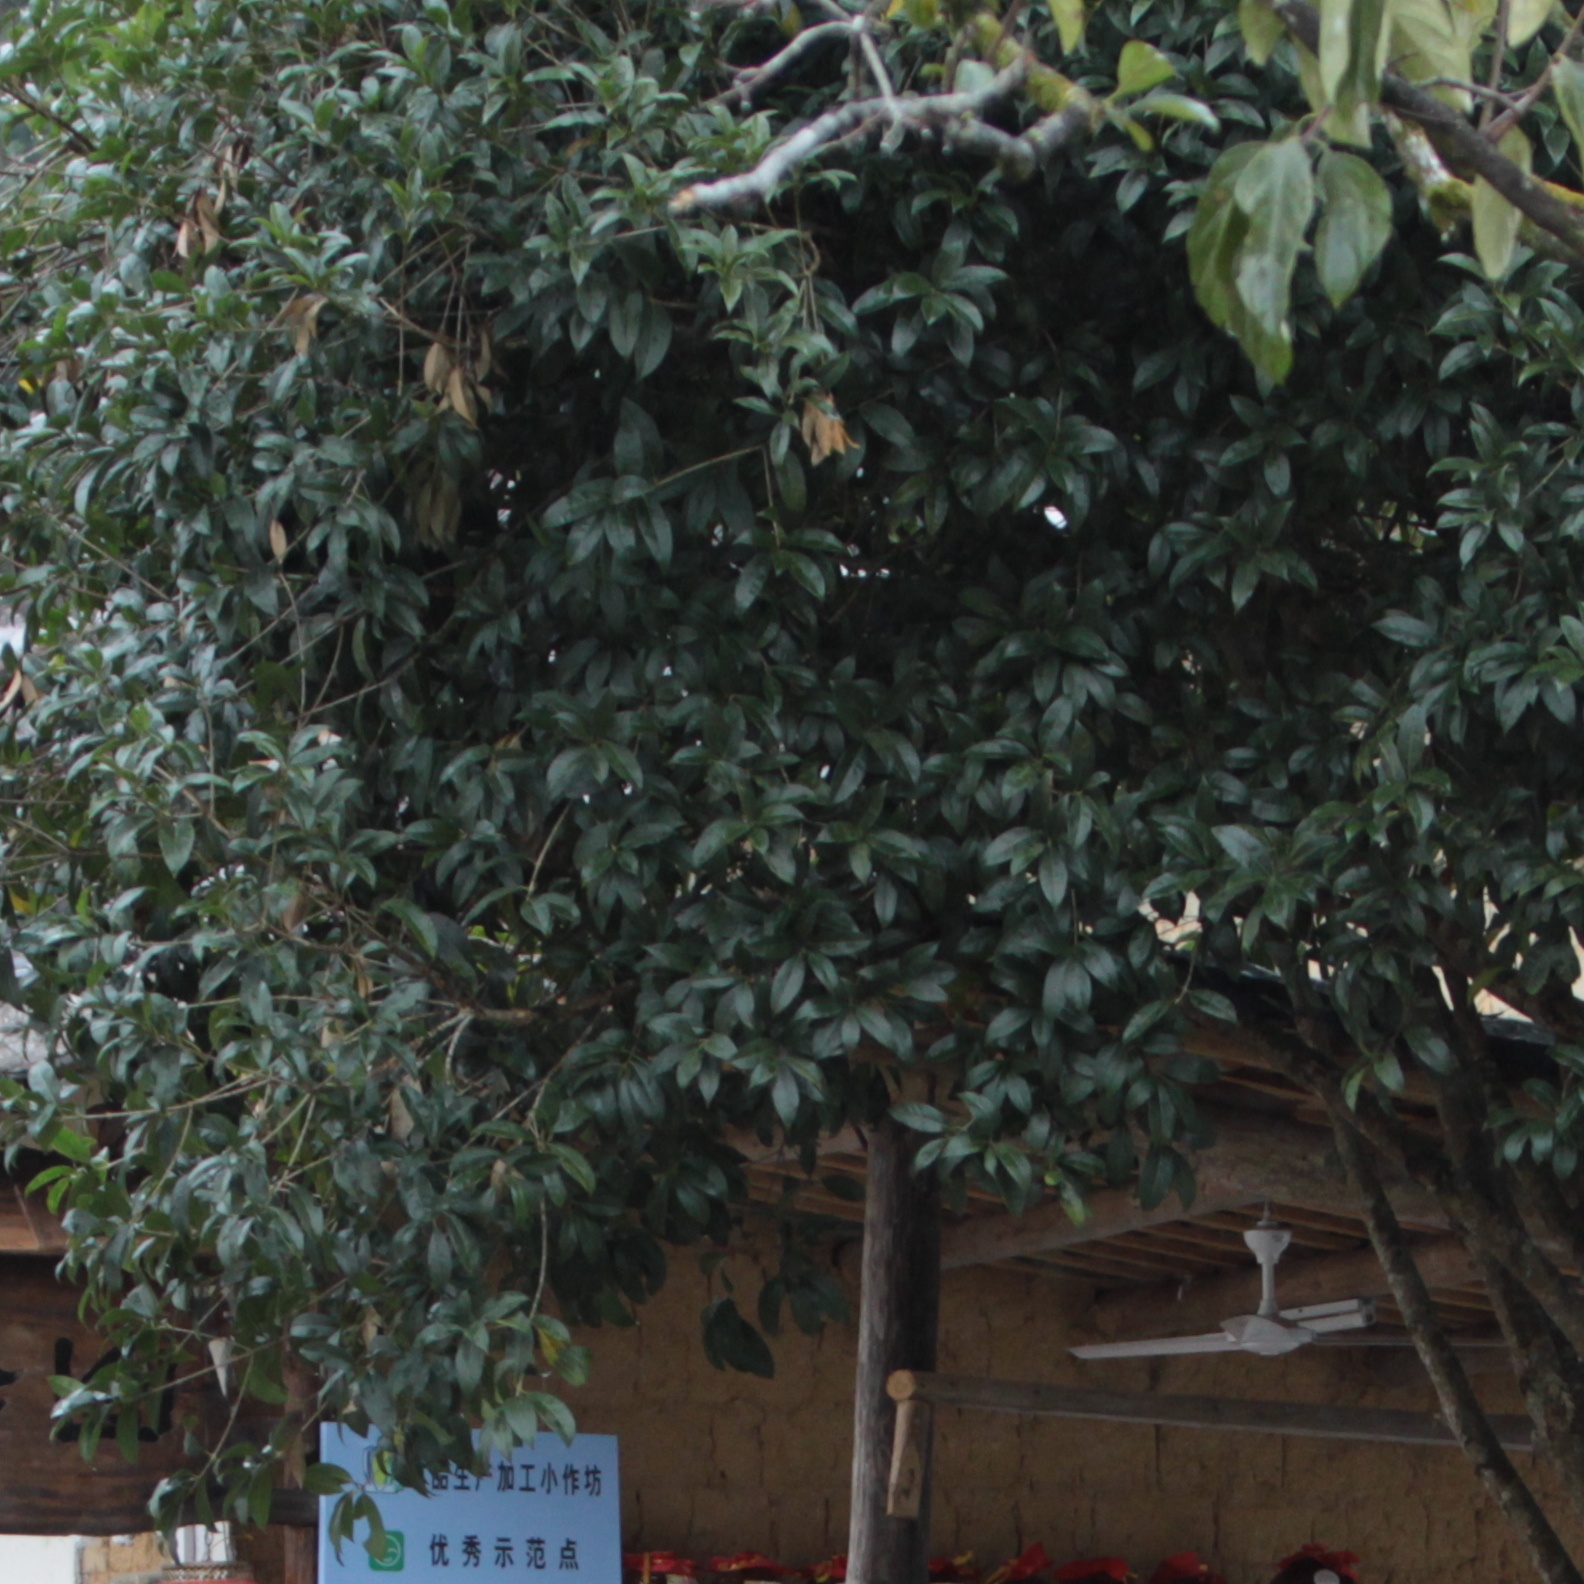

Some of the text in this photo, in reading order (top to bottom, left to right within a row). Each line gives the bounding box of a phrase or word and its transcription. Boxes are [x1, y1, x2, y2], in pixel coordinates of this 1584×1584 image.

[429, 1533, 580, 1570] 优秀示范点
